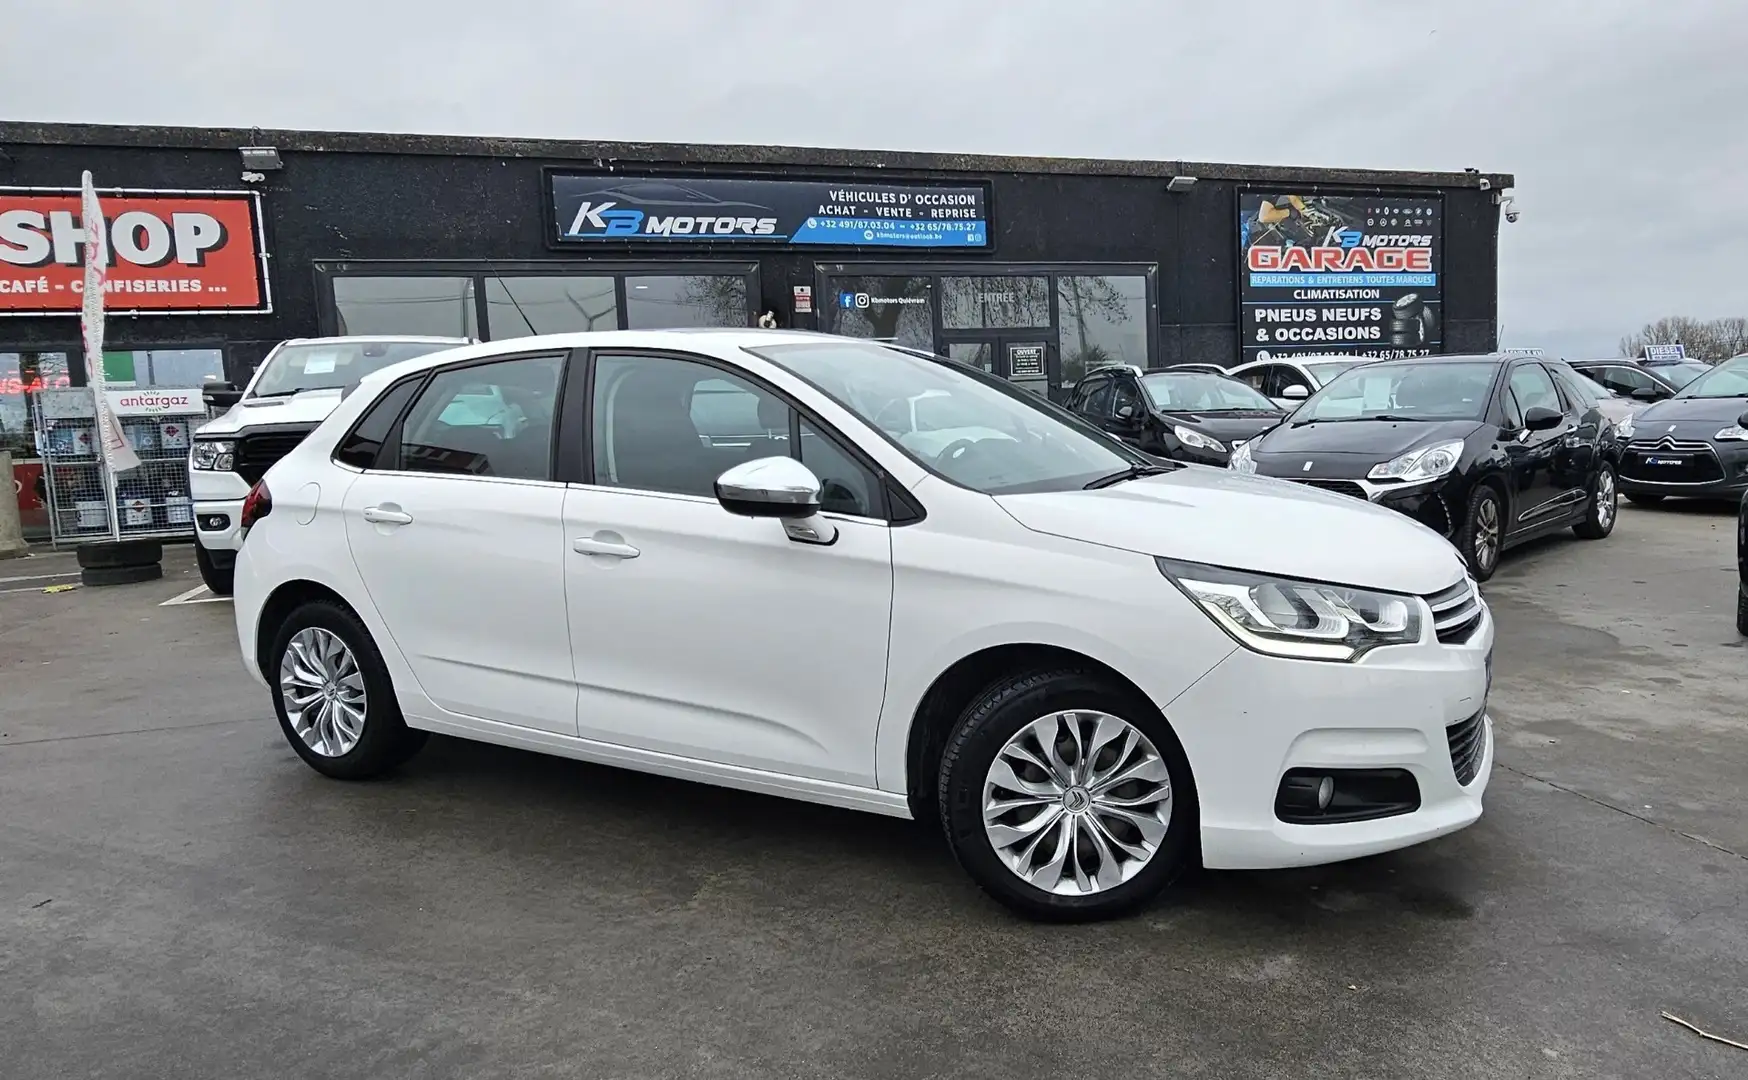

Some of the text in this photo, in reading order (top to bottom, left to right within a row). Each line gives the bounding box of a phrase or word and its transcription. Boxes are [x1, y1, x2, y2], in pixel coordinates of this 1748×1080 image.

[829, 189, 896, 203] VÉHICULES
[915, 194, 976, 205] OCCASION
[569, 202, 777, 236] KB MOTORS
[818, 205, 856, 215] ACHAT
[876, 207, 912, 217] VENTE
[931, 208, 977, 218] REPRISE
[910, 222, 925, 231] +32
[0, 209, 221, 265] SHOP
[1362, 235, 1432, 248] MOTORS
[1248, 246, 1432, 272] GARAGE
[0, 276, 49, 293] CAFÉ
[70, 278, 202, 293] CNFISERIES
[1308, 276, 1315, 284] &
[1316, 275, 1364, 285] ENTRETIENS
[1366, 275, 1395, 284] TOUTES
[1396, 275, 1432, 284] MARQUES
[1293, 289, 1380, 300] CLIMATISATION
[1254, 307, 1382, 322] PNEUS NEUFS
[1256, 326, 1381, 342] & OCCASIONS
[120, 396, 189, 409] antargaz
